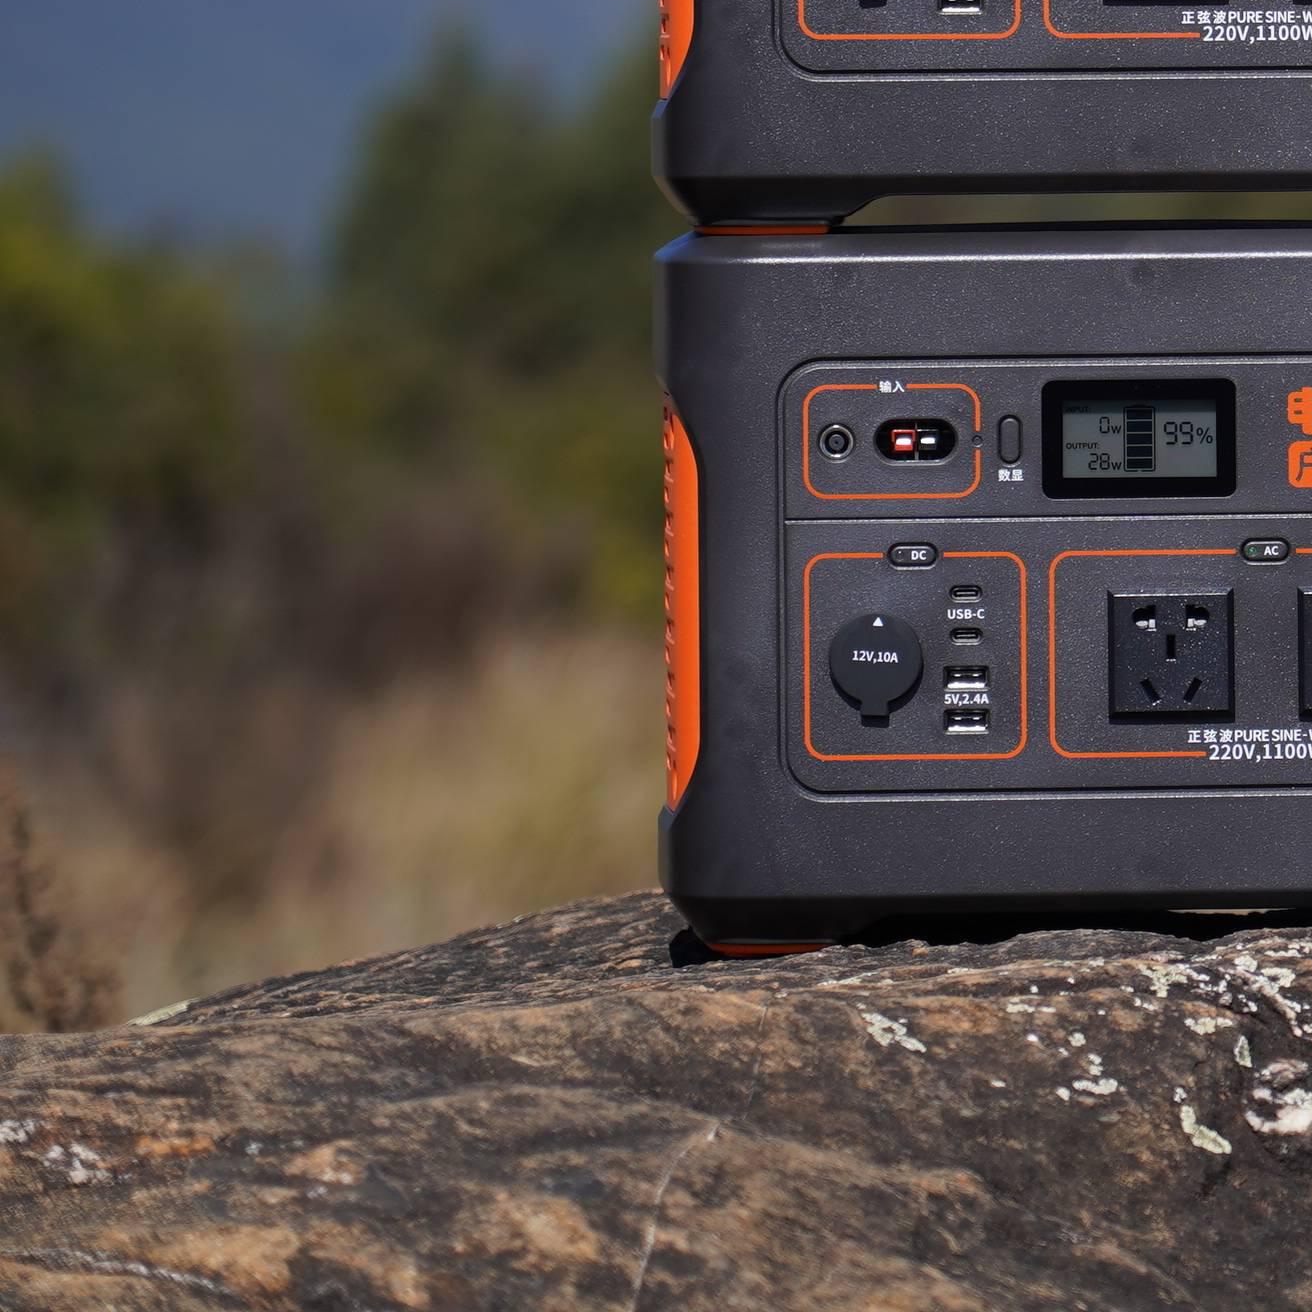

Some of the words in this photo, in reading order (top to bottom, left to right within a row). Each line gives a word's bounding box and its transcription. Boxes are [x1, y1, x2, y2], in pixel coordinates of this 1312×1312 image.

[878, 380, 906, 394] 输入
[1163, 420, 1214, 446] 99%
[997, 469, 1024, 483] 数显
[910, 550, 927, 561] DC
[1263, 545, 1280, 557] AC
[947, 608, 985, 620] USB-C
[851, 650, 899, 664] 12V,10A
[943, 693, 990, 706] 5V,2.4A
